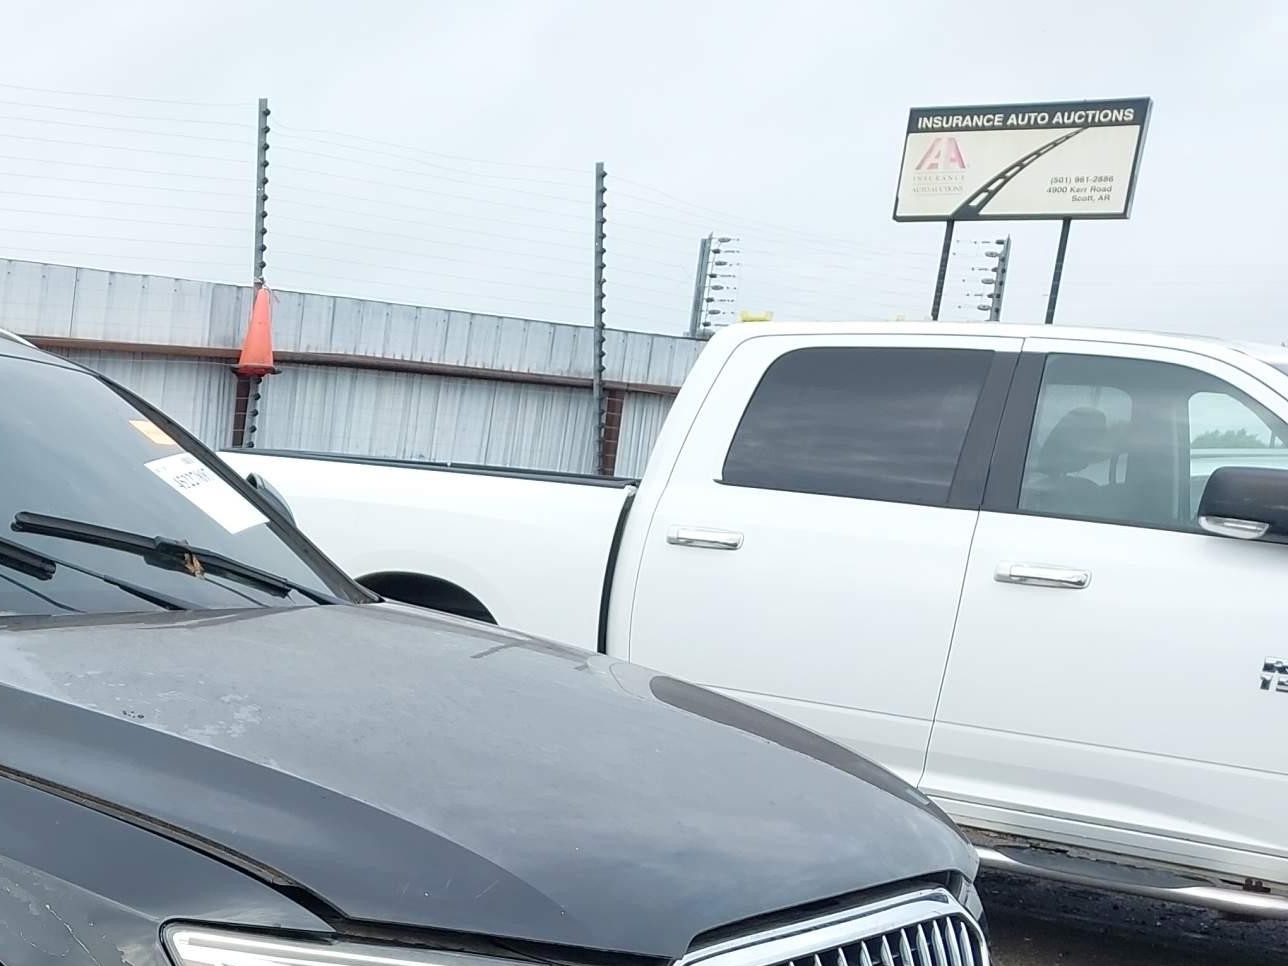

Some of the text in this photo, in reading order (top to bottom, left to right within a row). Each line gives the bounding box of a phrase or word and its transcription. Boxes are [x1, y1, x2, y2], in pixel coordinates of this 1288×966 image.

[918, 108, 1134, 128] INSURANCE AUTO AUCTIONS
[1090, 185, 1112, 193] Road
